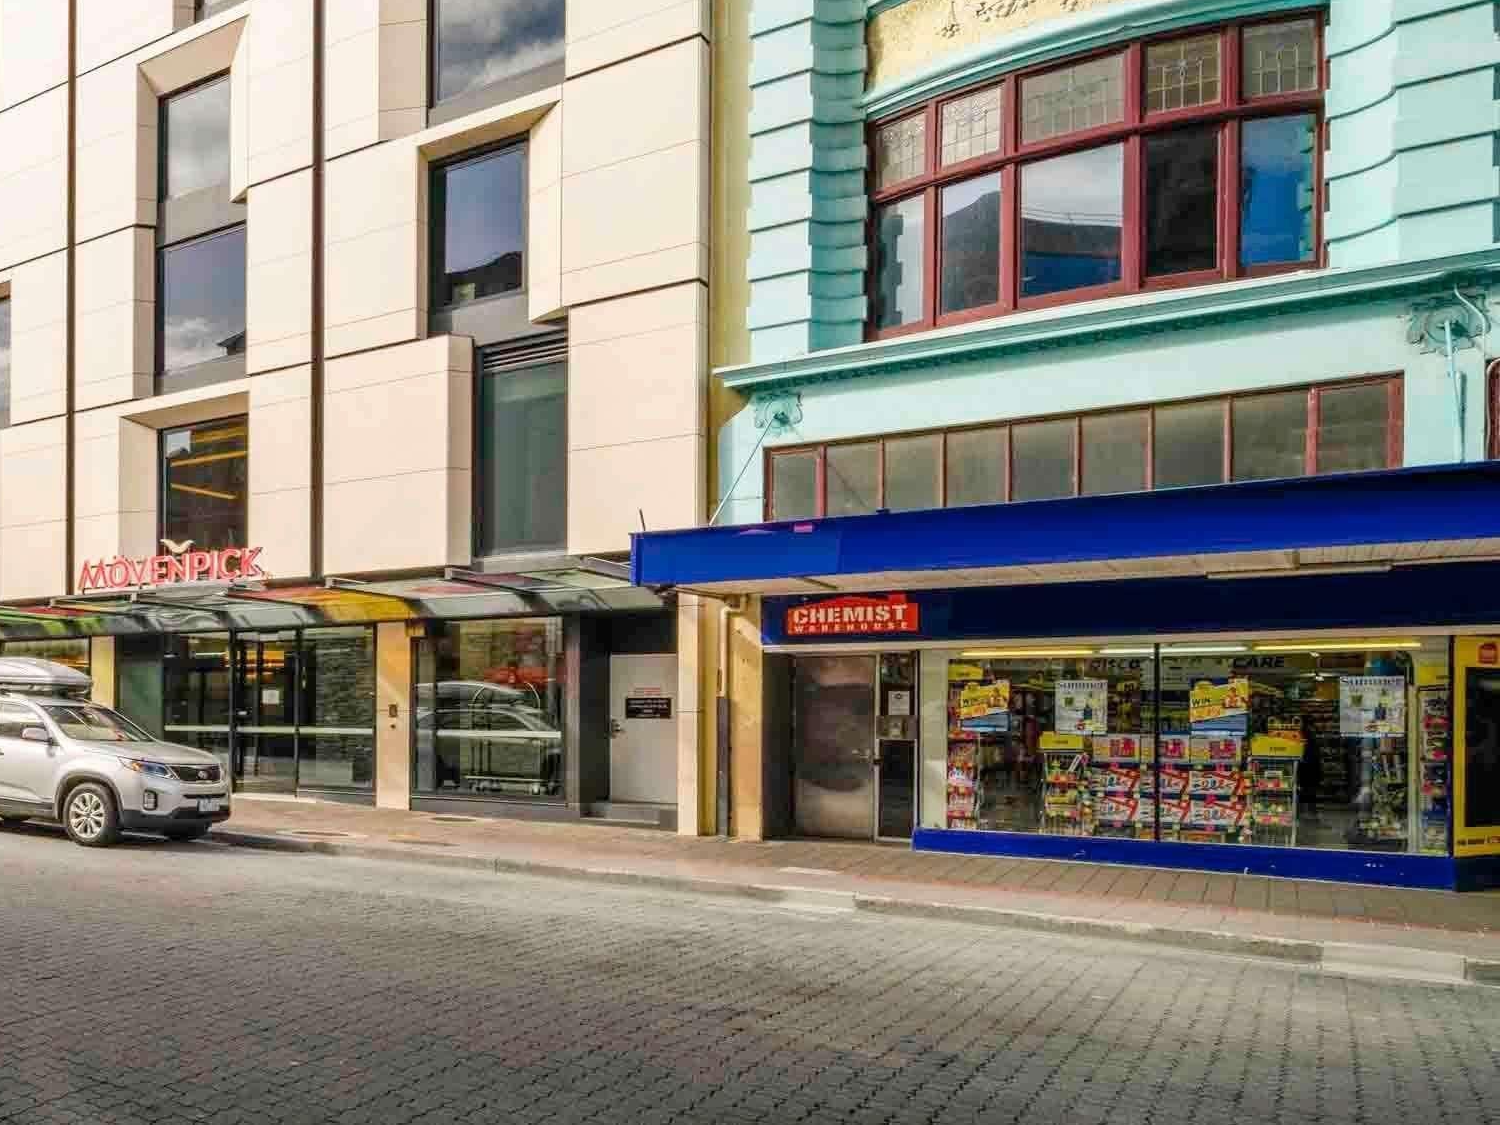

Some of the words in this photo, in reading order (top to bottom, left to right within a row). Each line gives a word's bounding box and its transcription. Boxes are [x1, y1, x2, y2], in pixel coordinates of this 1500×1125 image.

[79, 546, 264, 589] MÖVENPICK
[793, 604, 908, 624] CHEMIST
[794, 622, 909, 633] WAREHOUSE
